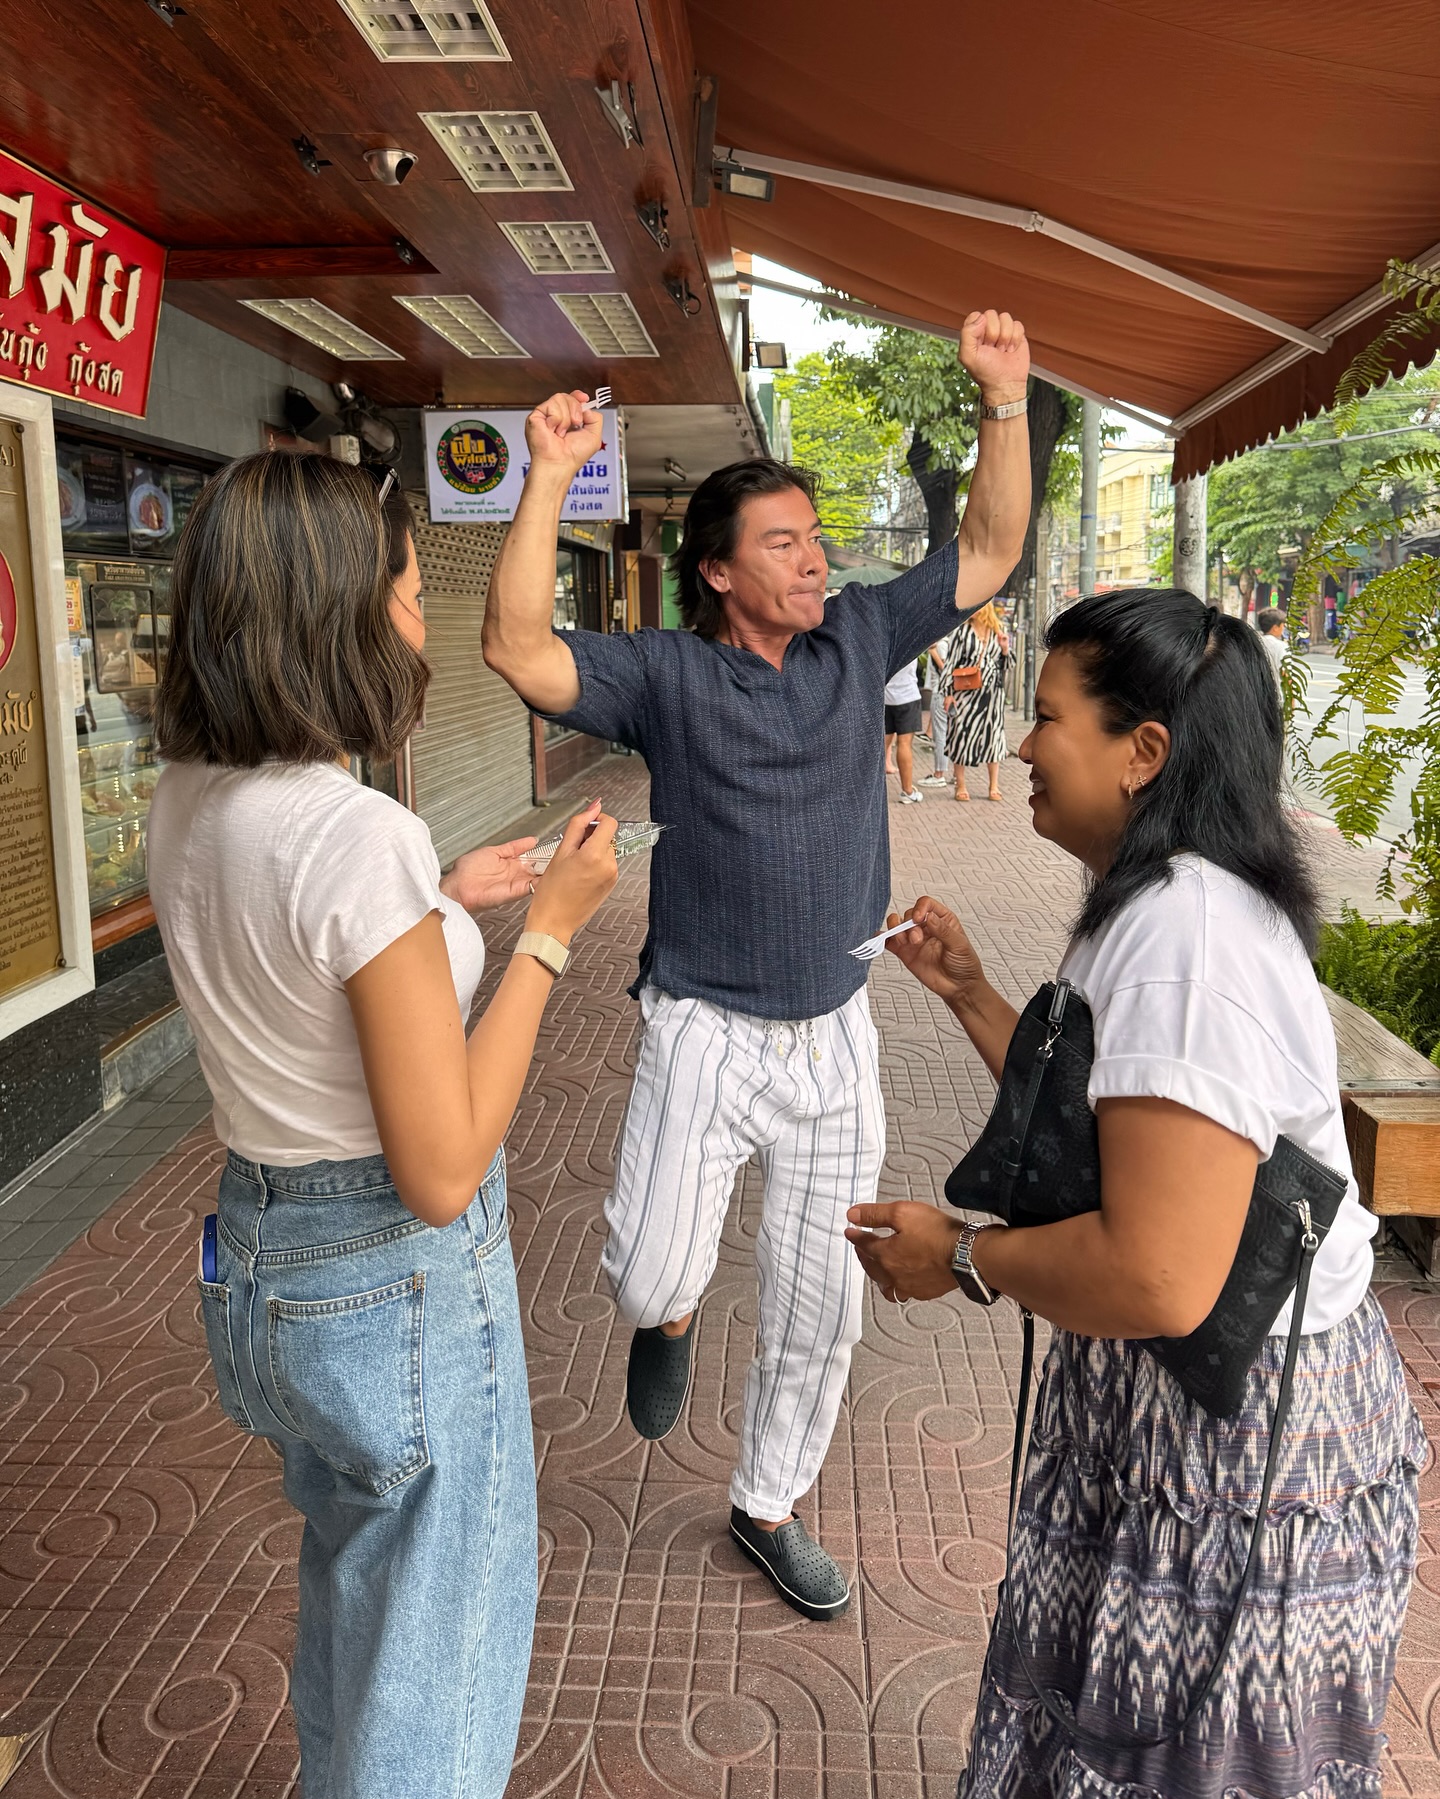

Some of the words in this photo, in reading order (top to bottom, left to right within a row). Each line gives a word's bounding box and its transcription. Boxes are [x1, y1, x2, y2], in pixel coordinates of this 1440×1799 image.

[70, 342, 124, 398] กุ้งสด
[570, 500, 603, 514] กุ้งสด
